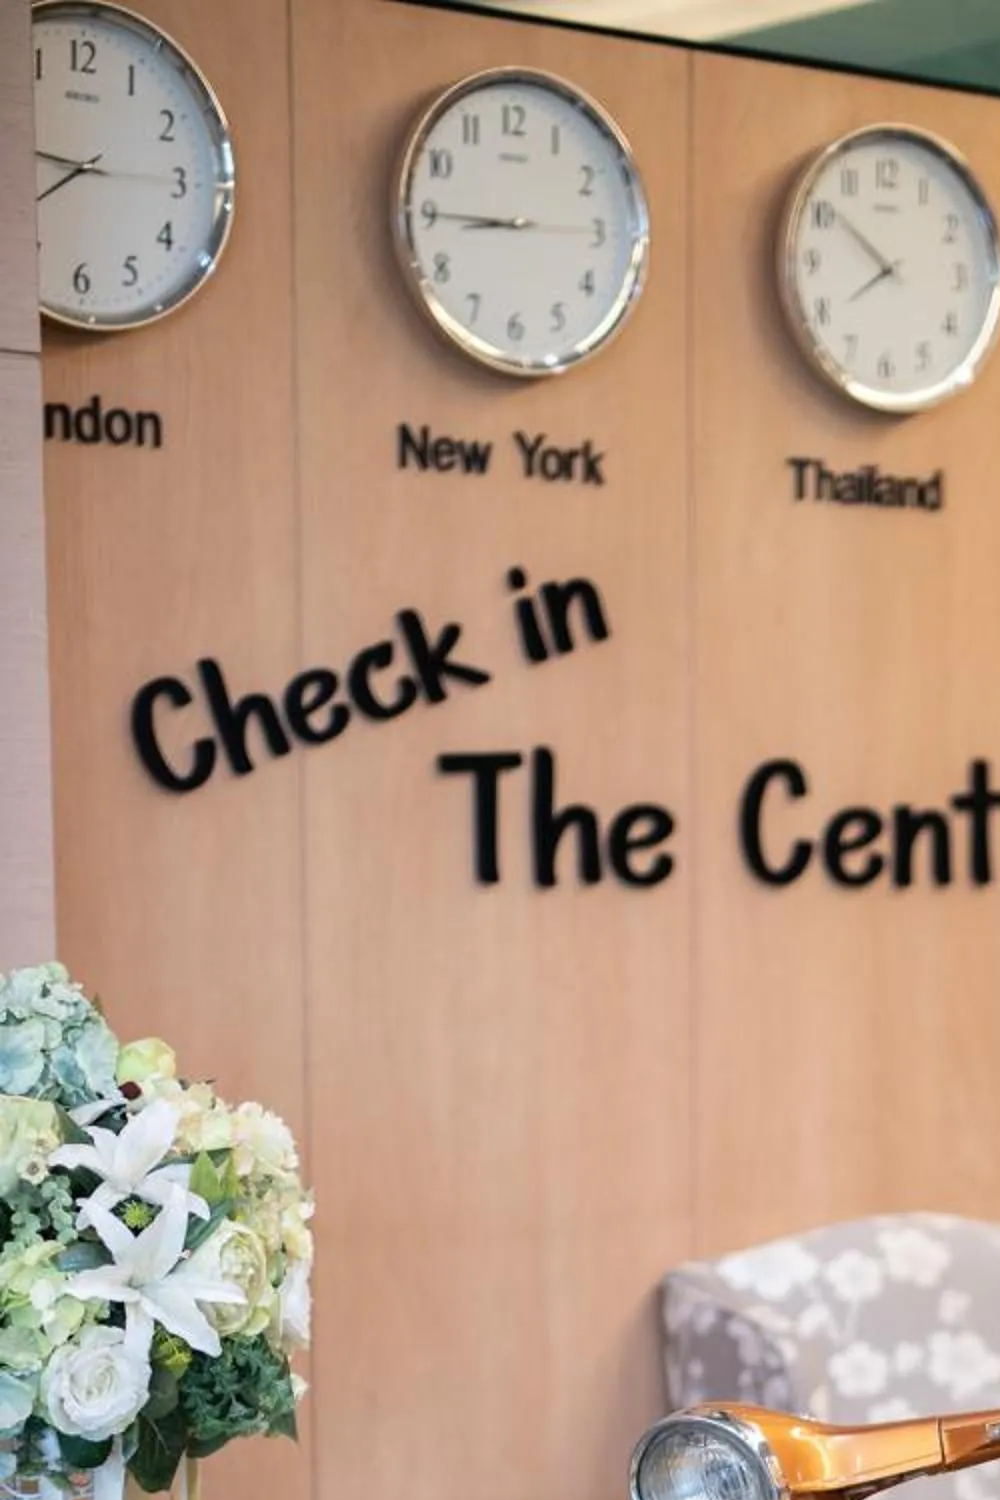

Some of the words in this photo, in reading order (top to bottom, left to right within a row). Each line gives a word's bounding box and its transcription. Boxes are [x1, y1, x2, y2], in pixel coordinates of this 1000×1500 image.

[69, 39, 97, 74] 12
[128, 64, 135, 97] 1
[159, 109, 176, 142] 2
[462, 114, 480, 146] 11
[501, 104, 527, 137] 12
[550, 125, 560, 155] 1
[429, 149, 453, 179] 10
[875, 157, 899, 190] 12
[170, 166, 188, 199] 3
[579, 165, 594, 196] 2
[421, 201, 437, 229] 9
[156, 220, 175, 252] 4
[593, 219, 606, 249] 3
[73, 262, 91, 294] 6
[121, 255, 139, 287] 5
[433, 253, 450, 284] 8
[579, 270, 595, 298] 4
[466, 294, 482, 326] 7
[550, 302, 566, 332] 5
[507, 313, 525, 341] 6
[44, 394, 162, 448] ndon
[397, 422, 493, 476] New
[513, 431, 606, 486] York
[786, 457, 945, 512] Thailand
[130, 607, 491, 795] Check
[505, 565, 611, 666] in
[435, 745, 676, 890] The
